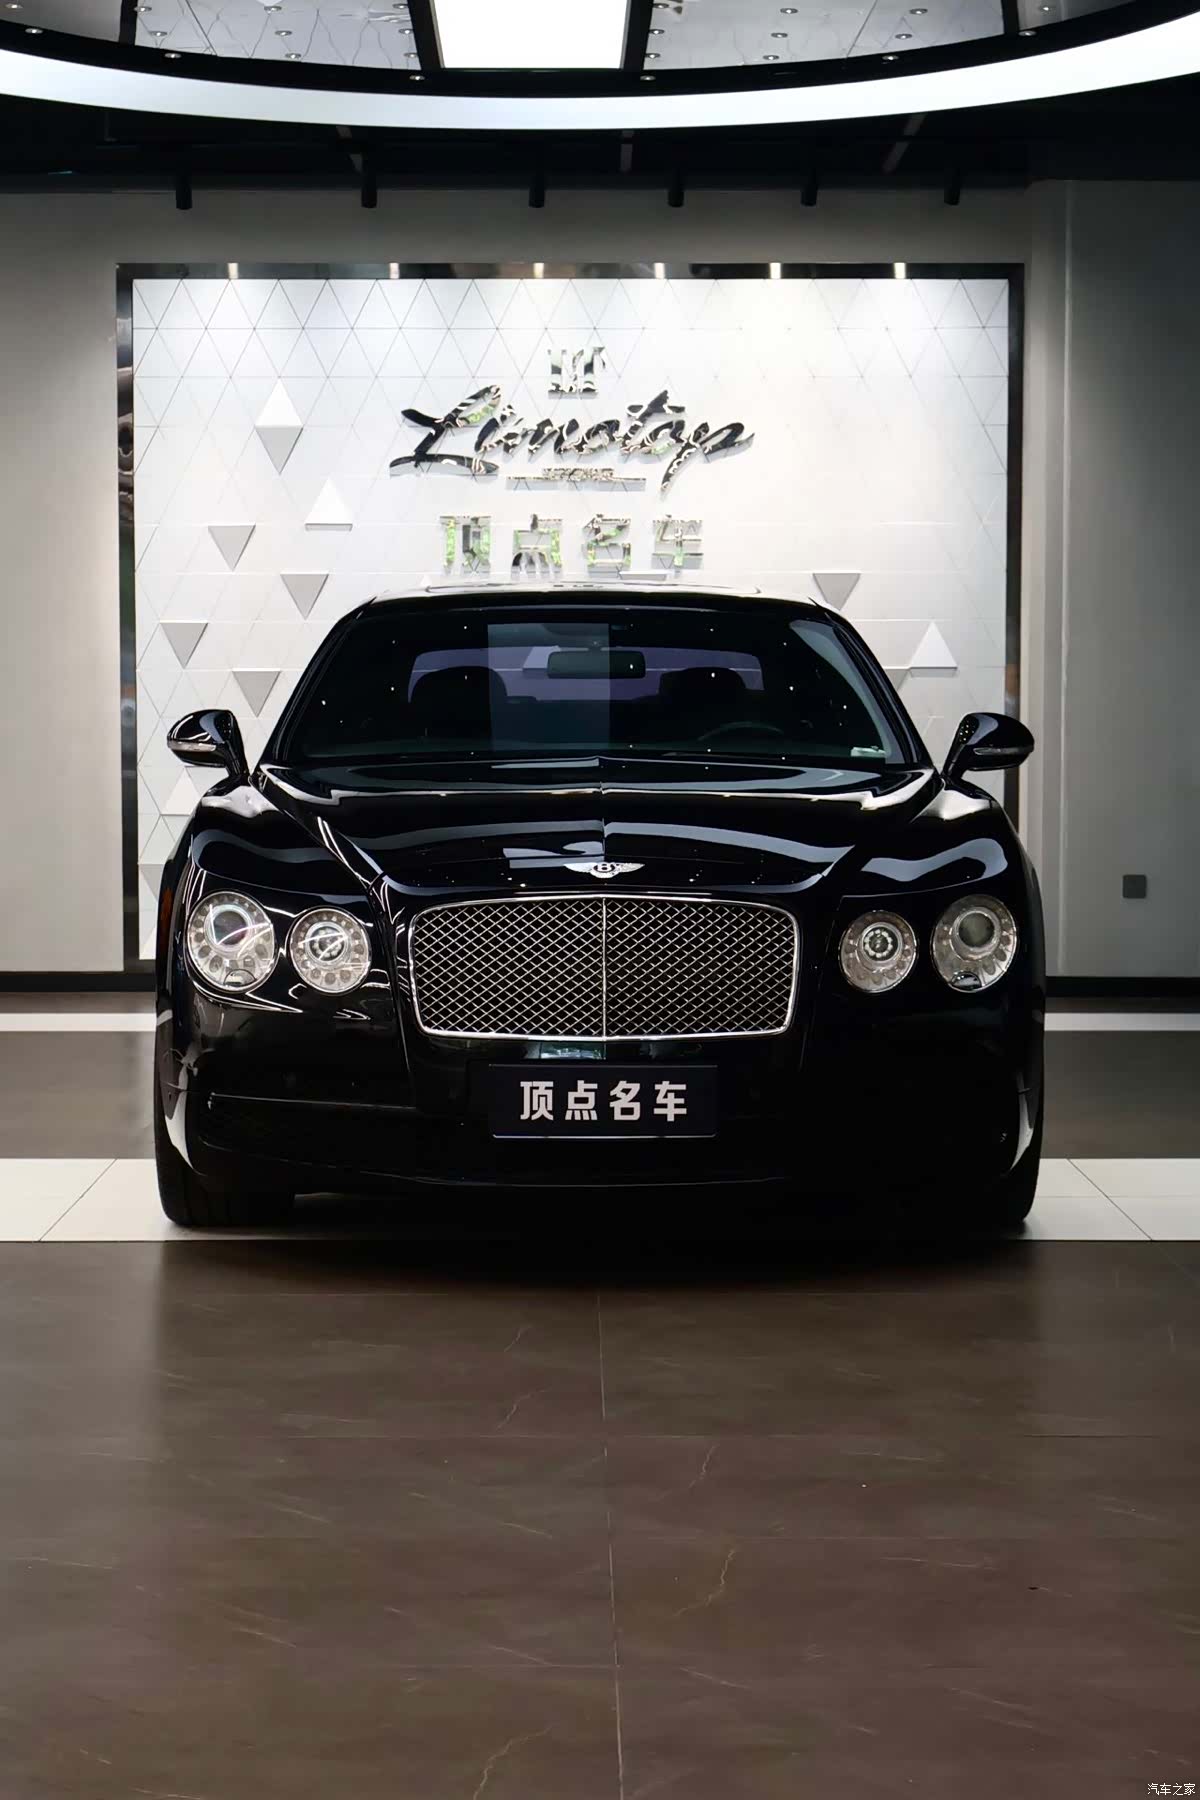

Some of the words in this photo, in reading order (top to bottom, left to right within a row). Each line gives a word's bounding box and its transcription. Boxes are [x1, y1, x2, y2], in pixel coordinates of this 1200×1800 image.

[439, 513, 704, 568] 顶点名车
[520, 1080, 687, 1122] 顶点名车
